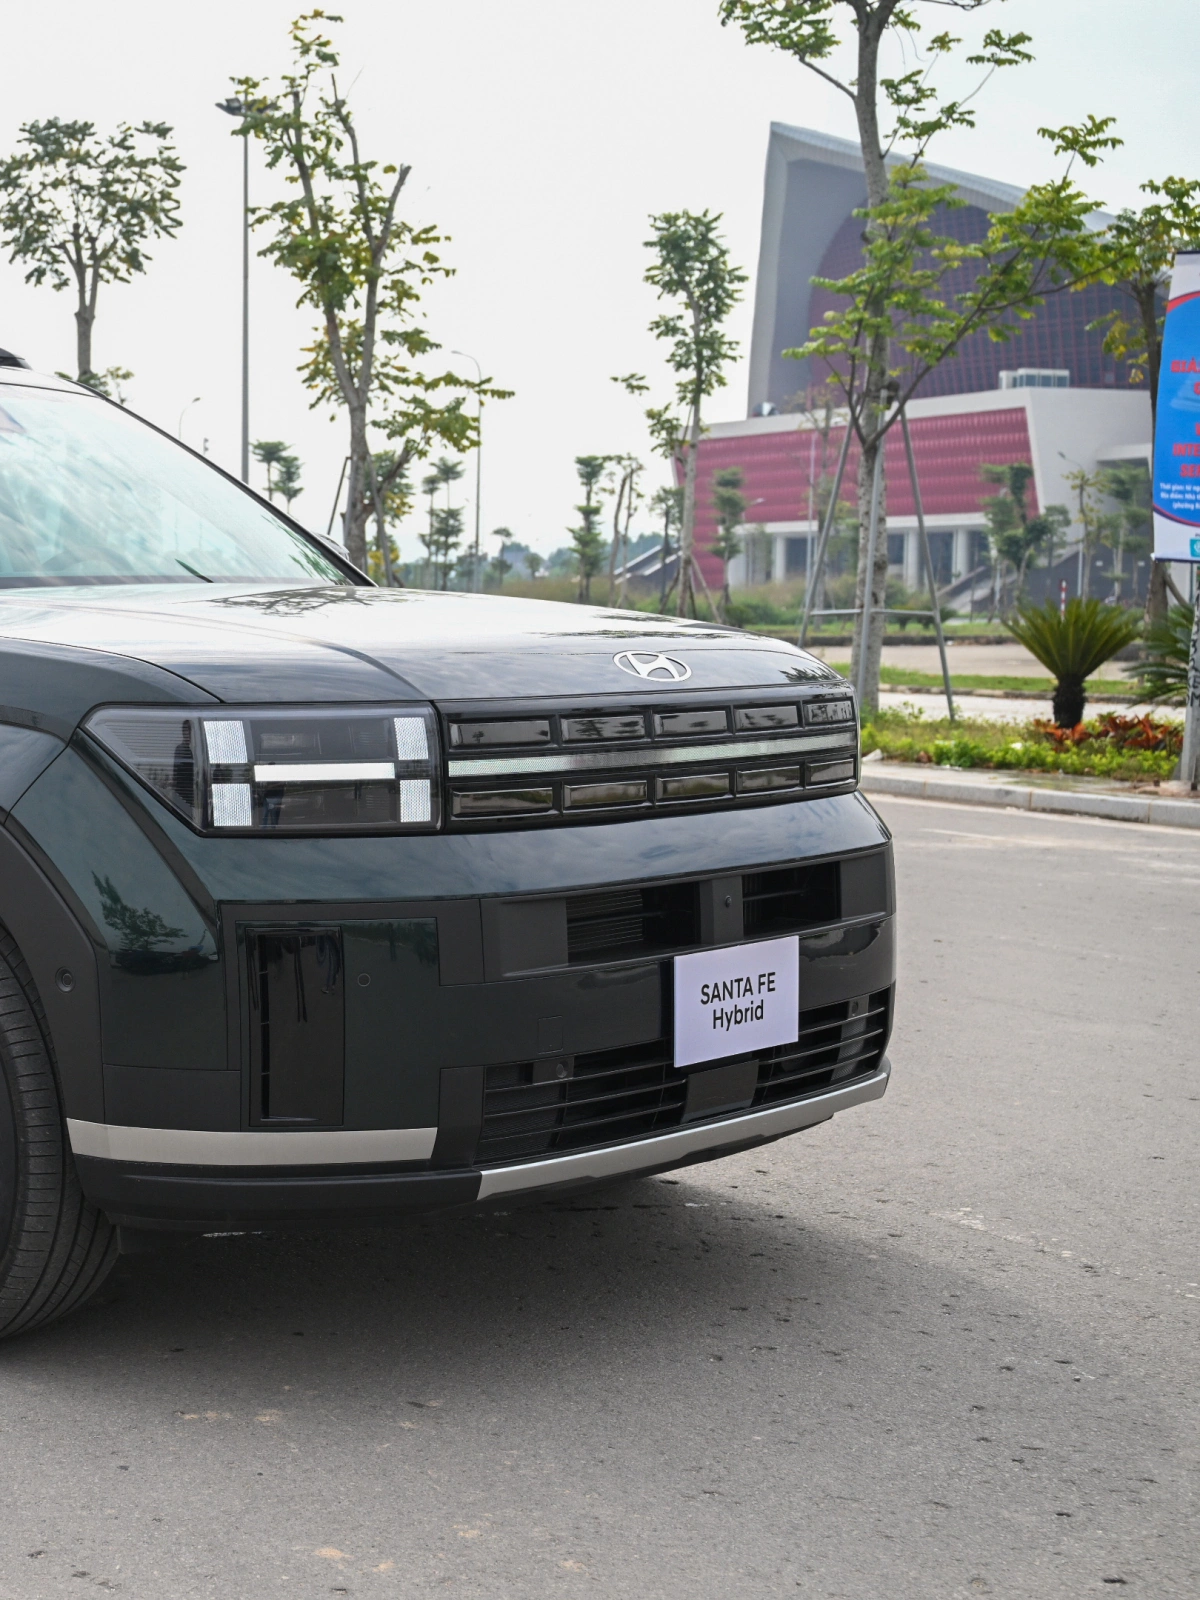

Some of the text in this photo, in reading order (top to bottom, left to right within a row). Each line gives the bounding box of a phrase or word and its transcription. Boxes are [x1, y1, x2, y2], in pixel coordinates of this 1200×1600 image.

[700, 972, 776, 1005] SANTA FE
[712, 999, 764, 1031] Hybrid
